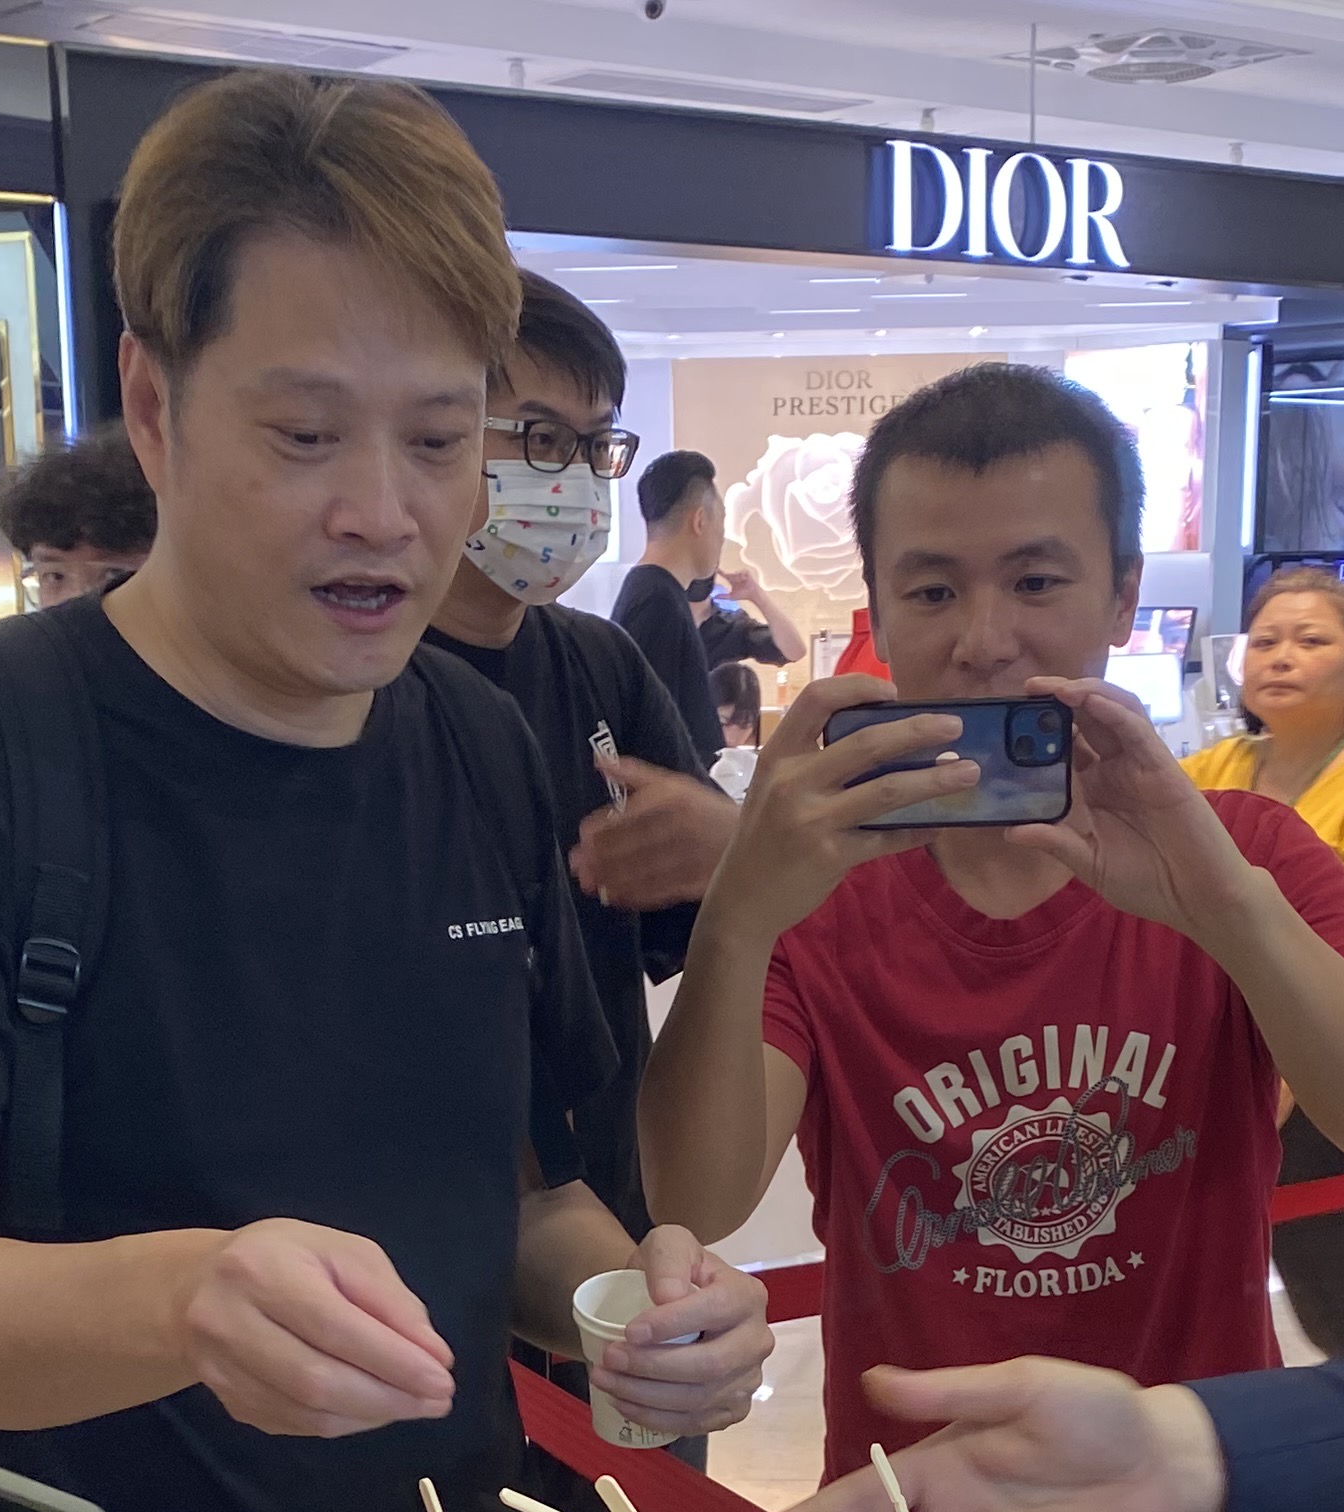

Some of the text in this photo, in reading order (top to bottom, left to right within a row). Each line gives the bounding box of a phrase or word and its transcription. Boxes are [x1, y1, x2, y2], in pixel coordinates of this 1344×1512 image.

[885, 140, 1131, 268] DIOR
[806, 370, 873, 390] DIOR
[893, 1024, 1177, 1144] ORIGINAL
[972, 1121, 1041, 1193] AMERICAN
[973, 1256, 1126, 1298] FLORIDA
